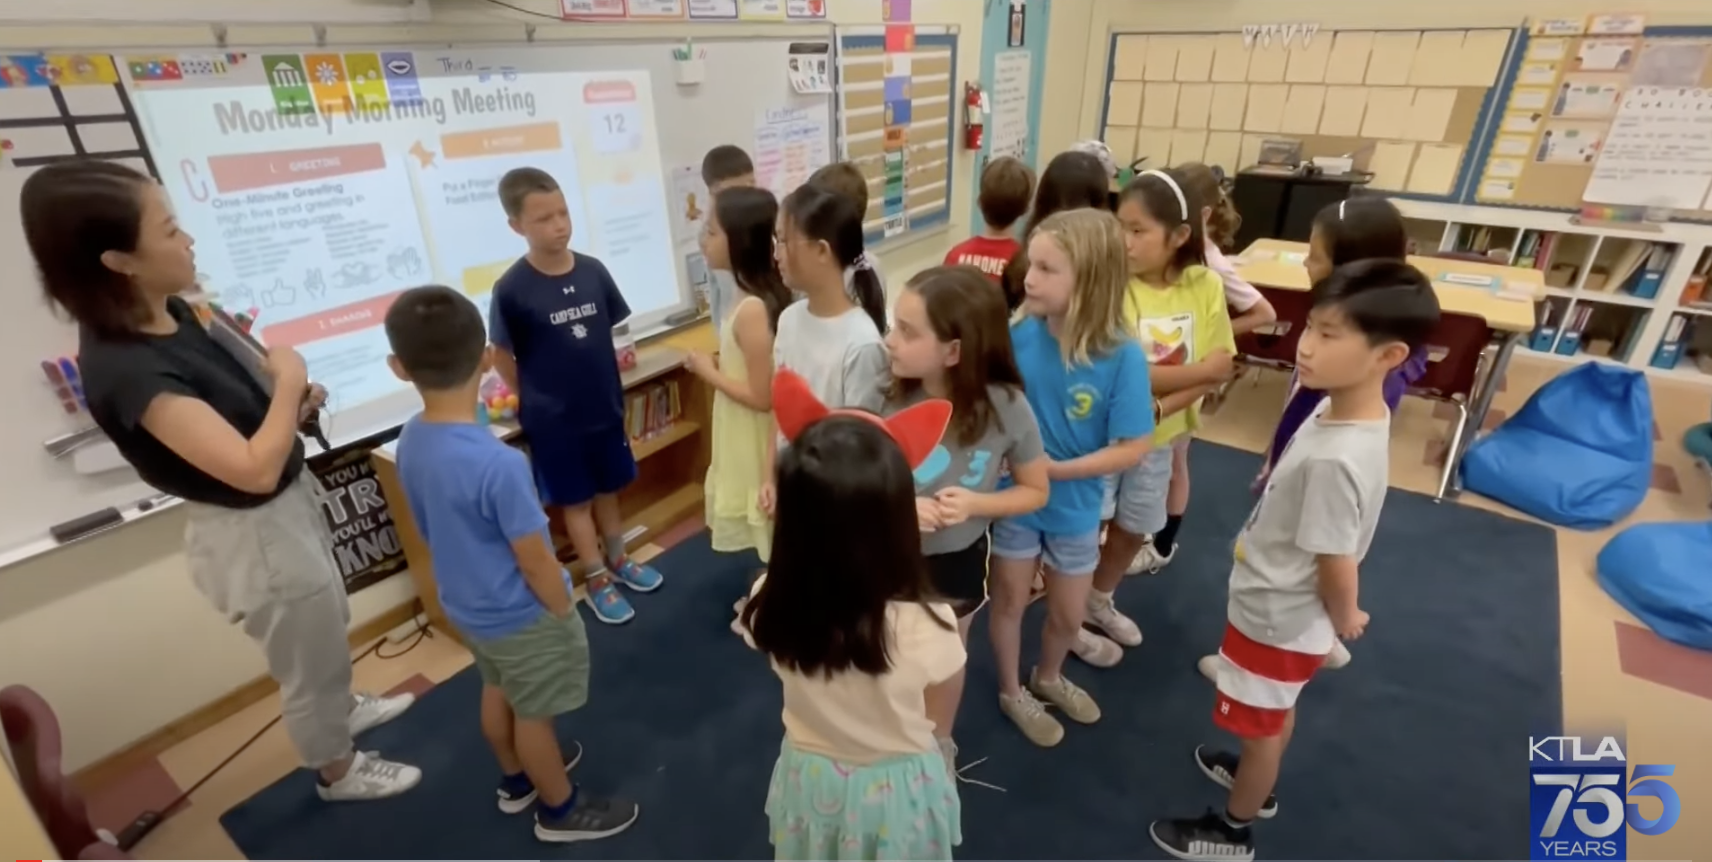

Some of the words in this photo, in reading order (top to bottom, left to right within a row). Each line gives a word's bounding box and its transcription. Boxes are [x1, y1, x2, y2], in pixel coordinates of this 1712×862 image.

[436, 57, 473, 73] Third
[213, 96, 335, 135] Monday
[342, 93, 446, 124] Morning
[452, 87, 536, 117] Meeting
[604, 113, 627, 134] 12
[293, 183, 344, 198] Greeting
[277, 204, 302, 215] and
[305, 196, 353, 213] greeting
[325, 463, 358, 486] YOU
[334, 525, 400, 577] KNO
